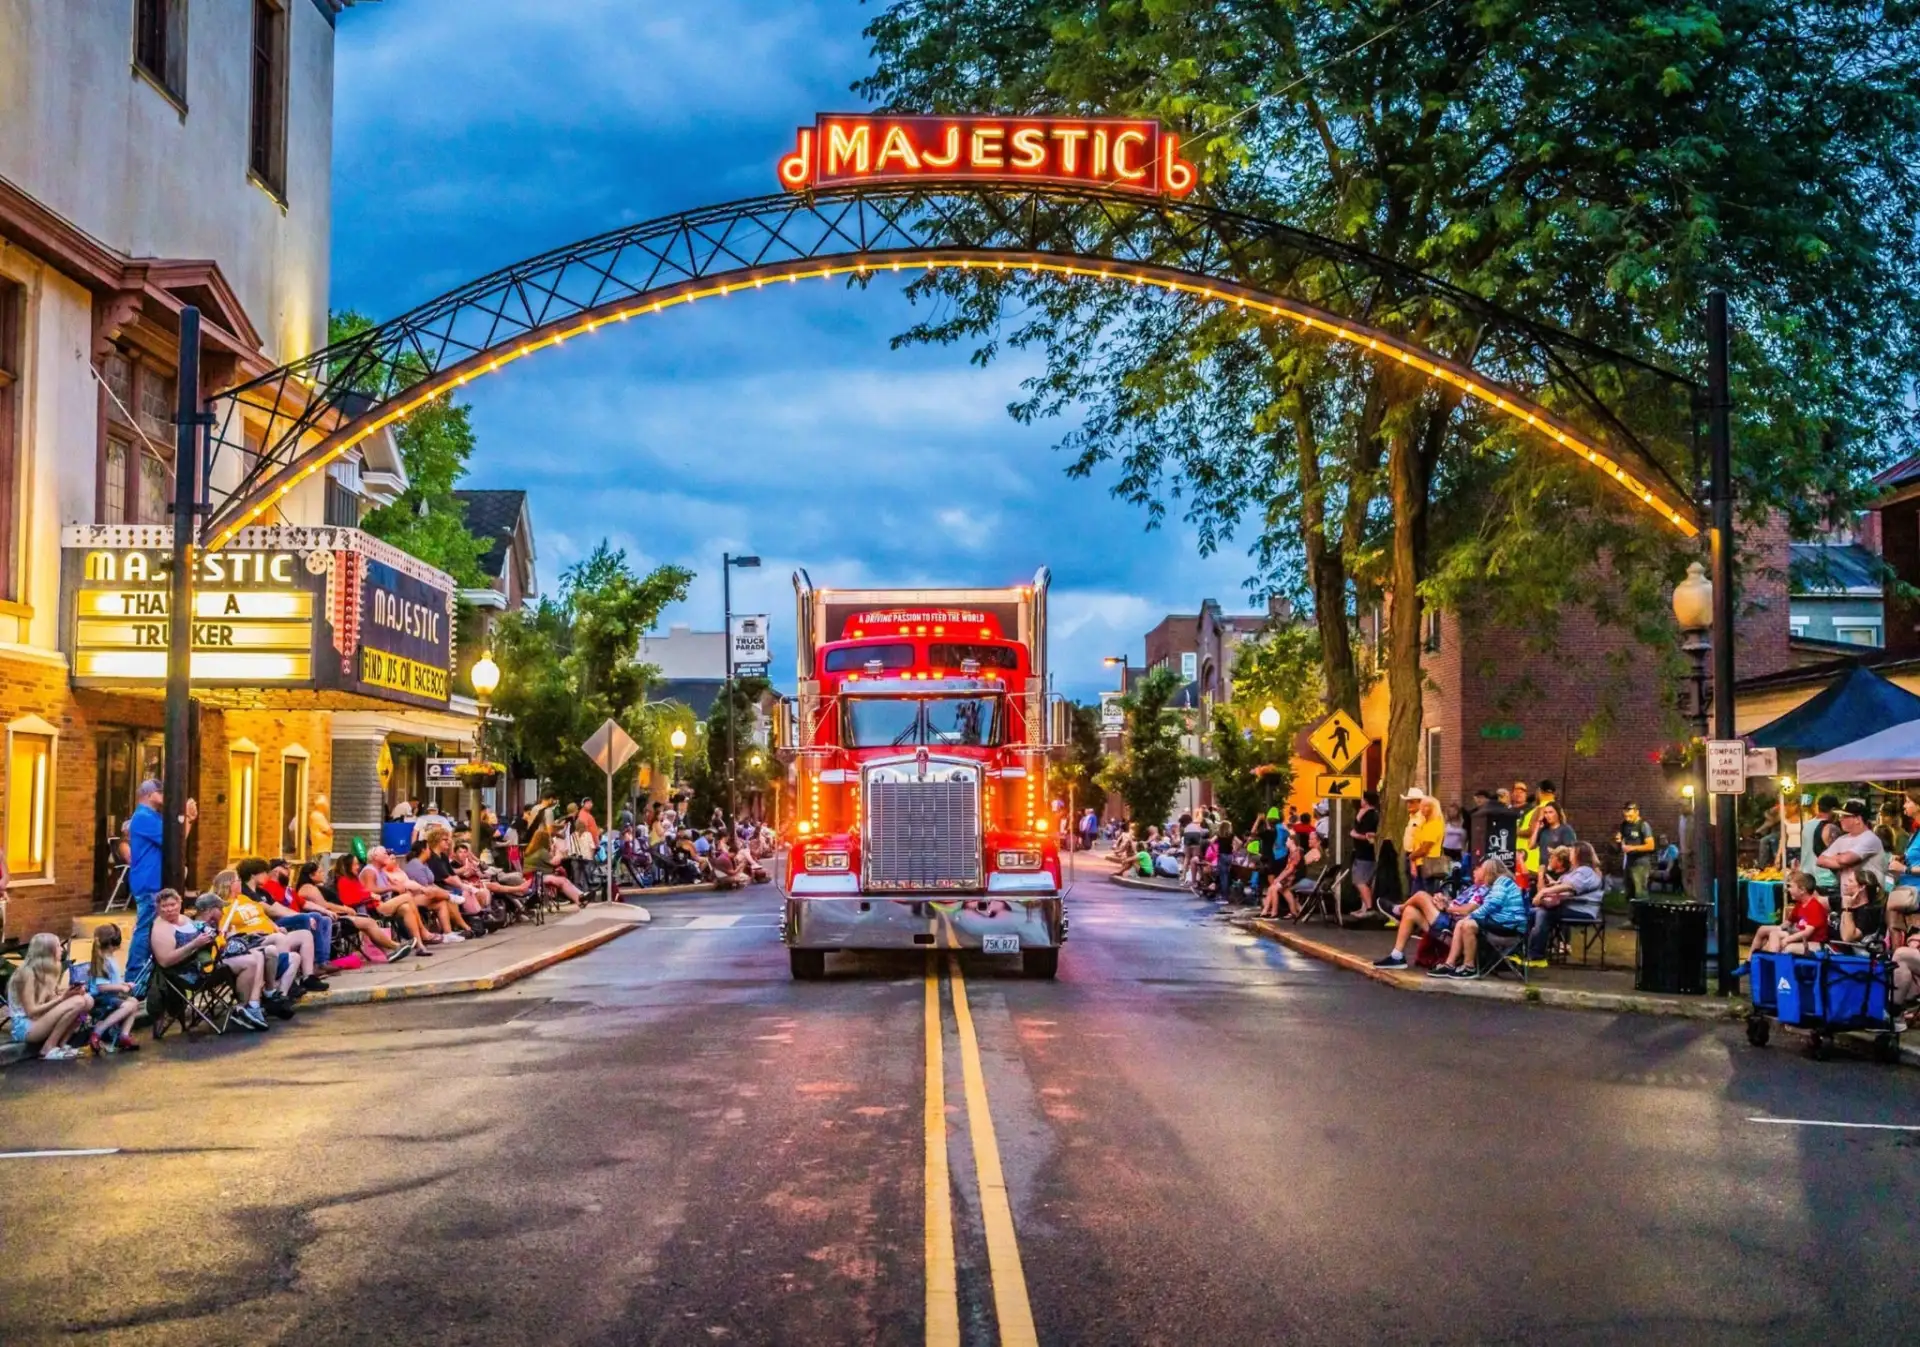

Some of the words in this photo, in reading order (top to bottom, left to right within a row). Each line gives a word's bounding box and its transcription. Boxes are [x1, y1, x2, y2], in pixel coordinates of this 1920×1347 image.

[826, 123, 1148, 180] MAJESTIC
[223, 593, 241, 615] A
[373, 588, 440, 645] MAJESTIC
[858, 613, 864, 624] A
[893, 612, 921, 622] PASSION
[922, 612, 931, 622] TO
[948, 612, 961, 622] THE
[962, 612, 985, 623] WORLD
[131, 623, 234, 646] TRUKER
[363, 650, 383, 682] FIND
[387, 657, 397, 684] US
[400, 661, 411, 692] ON
[1711, 768, 1740, 776] PARKING
[1716, 779, 1735, 787] ONLY
